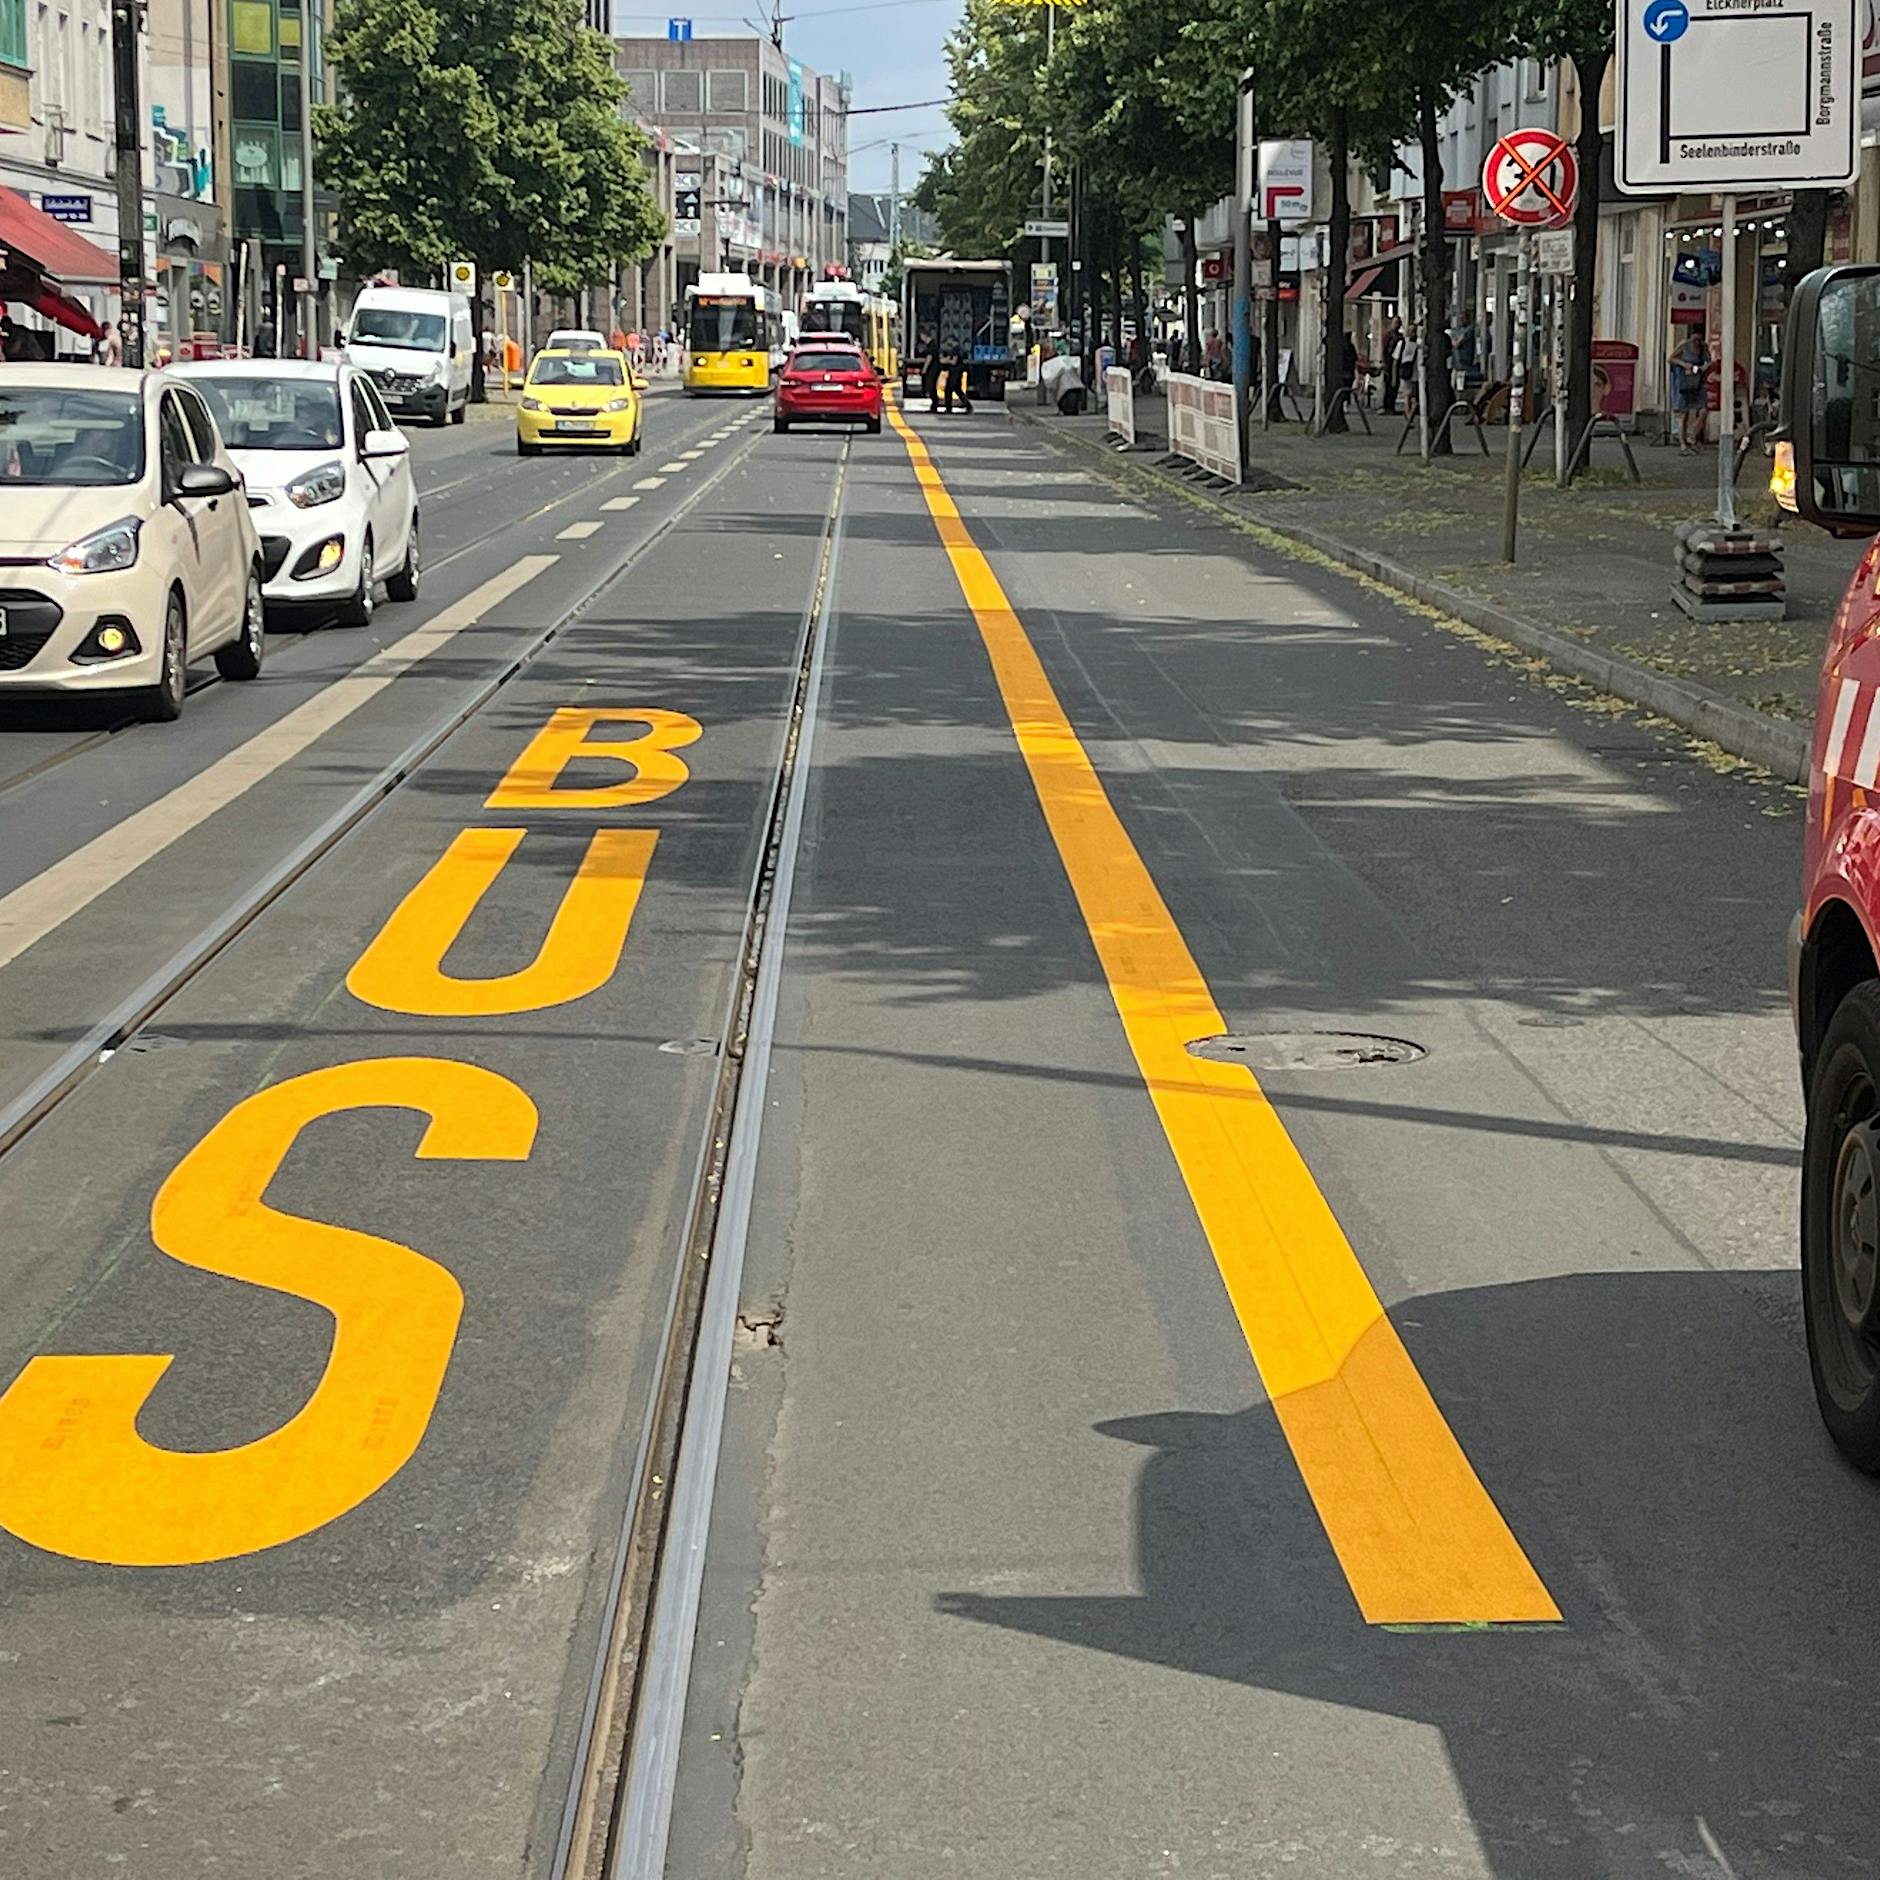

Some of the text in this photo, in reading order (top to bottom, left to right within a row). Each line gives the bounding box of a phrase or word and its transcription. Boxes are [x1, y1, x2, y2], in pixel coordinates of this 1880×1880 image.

[672, 20, 689, 40] T
[1816, 22, 1834, 125] Borgmannstraße
[1680, 140, 1801, 158] Seelenbinderstraße
[1505, 157, 1556, 198] 30
